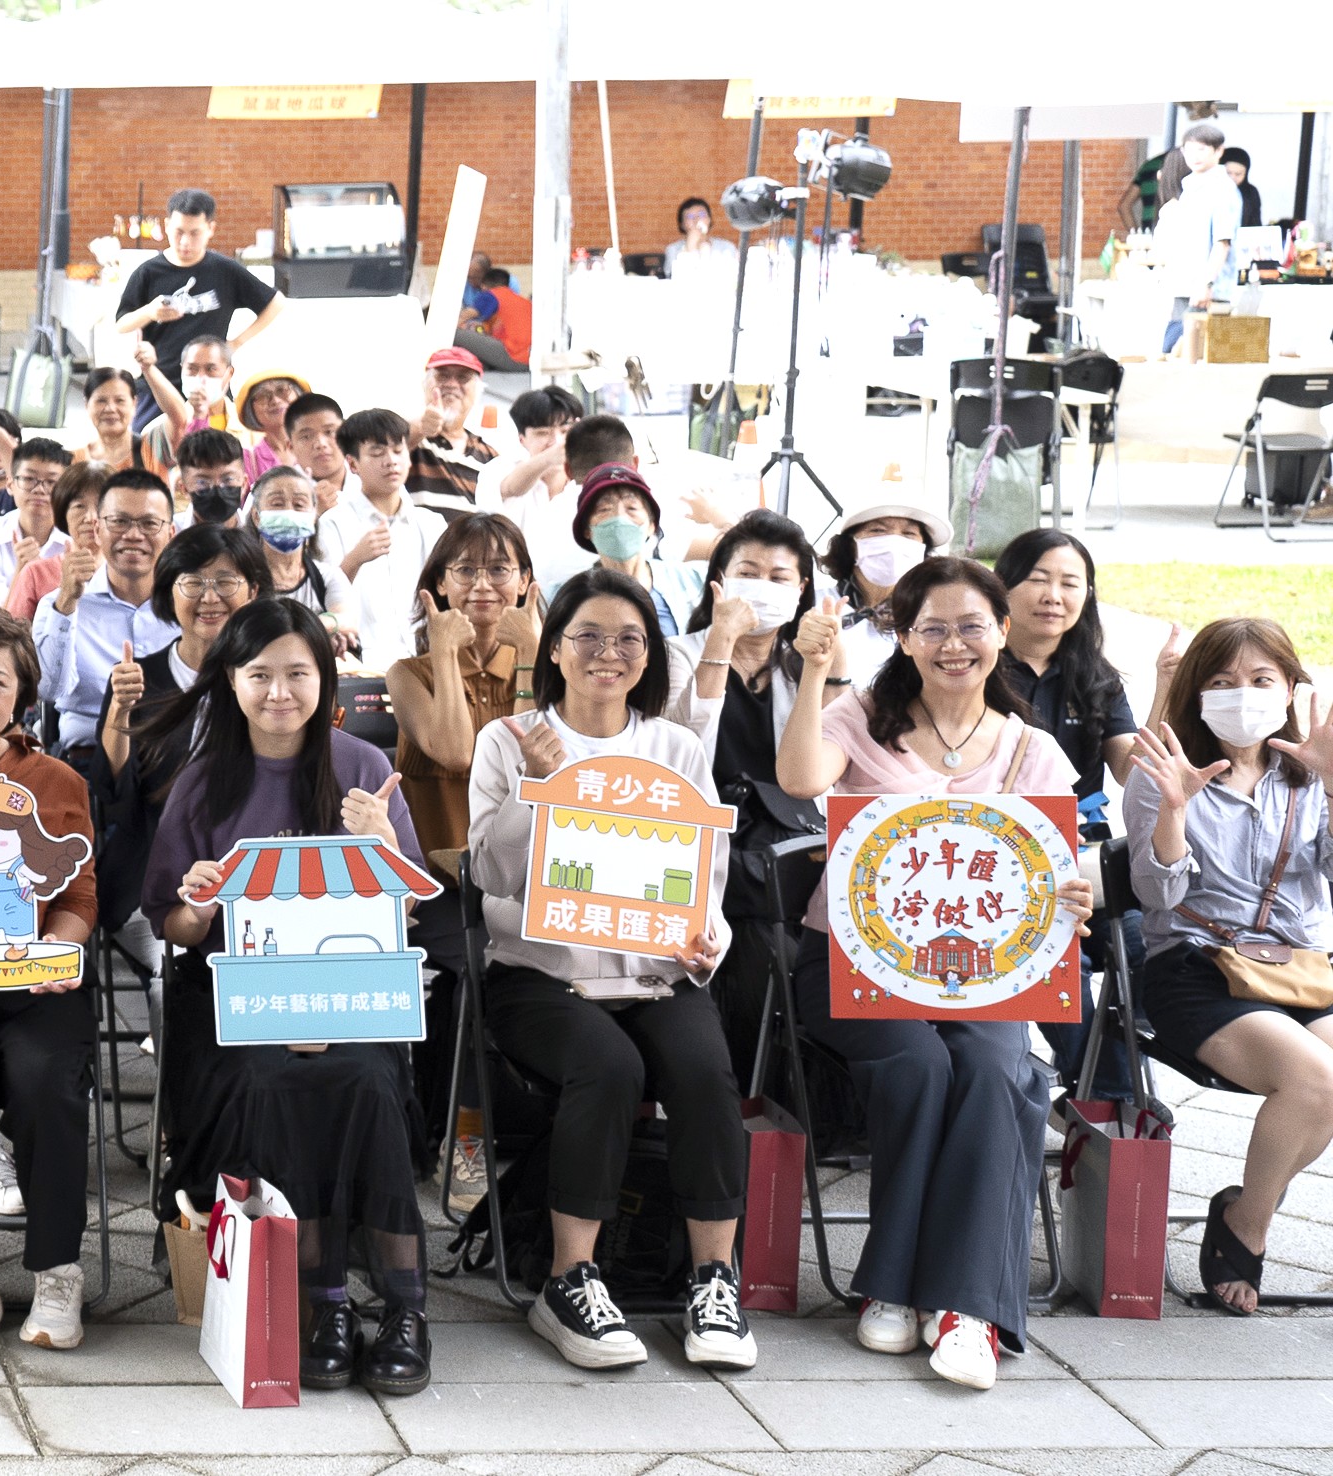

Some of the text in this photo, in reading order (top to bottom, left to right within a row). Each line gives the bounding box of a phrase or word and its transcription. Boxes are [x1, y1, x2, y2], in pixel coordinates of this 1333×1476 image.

[575, 768, 681, 812] 青少年
[901, 839, 998, 886] 少年匯
[543, 898, 689, 948] 成果匯演
[229, 991, 412, 1015] 青少年藝術育成基地
